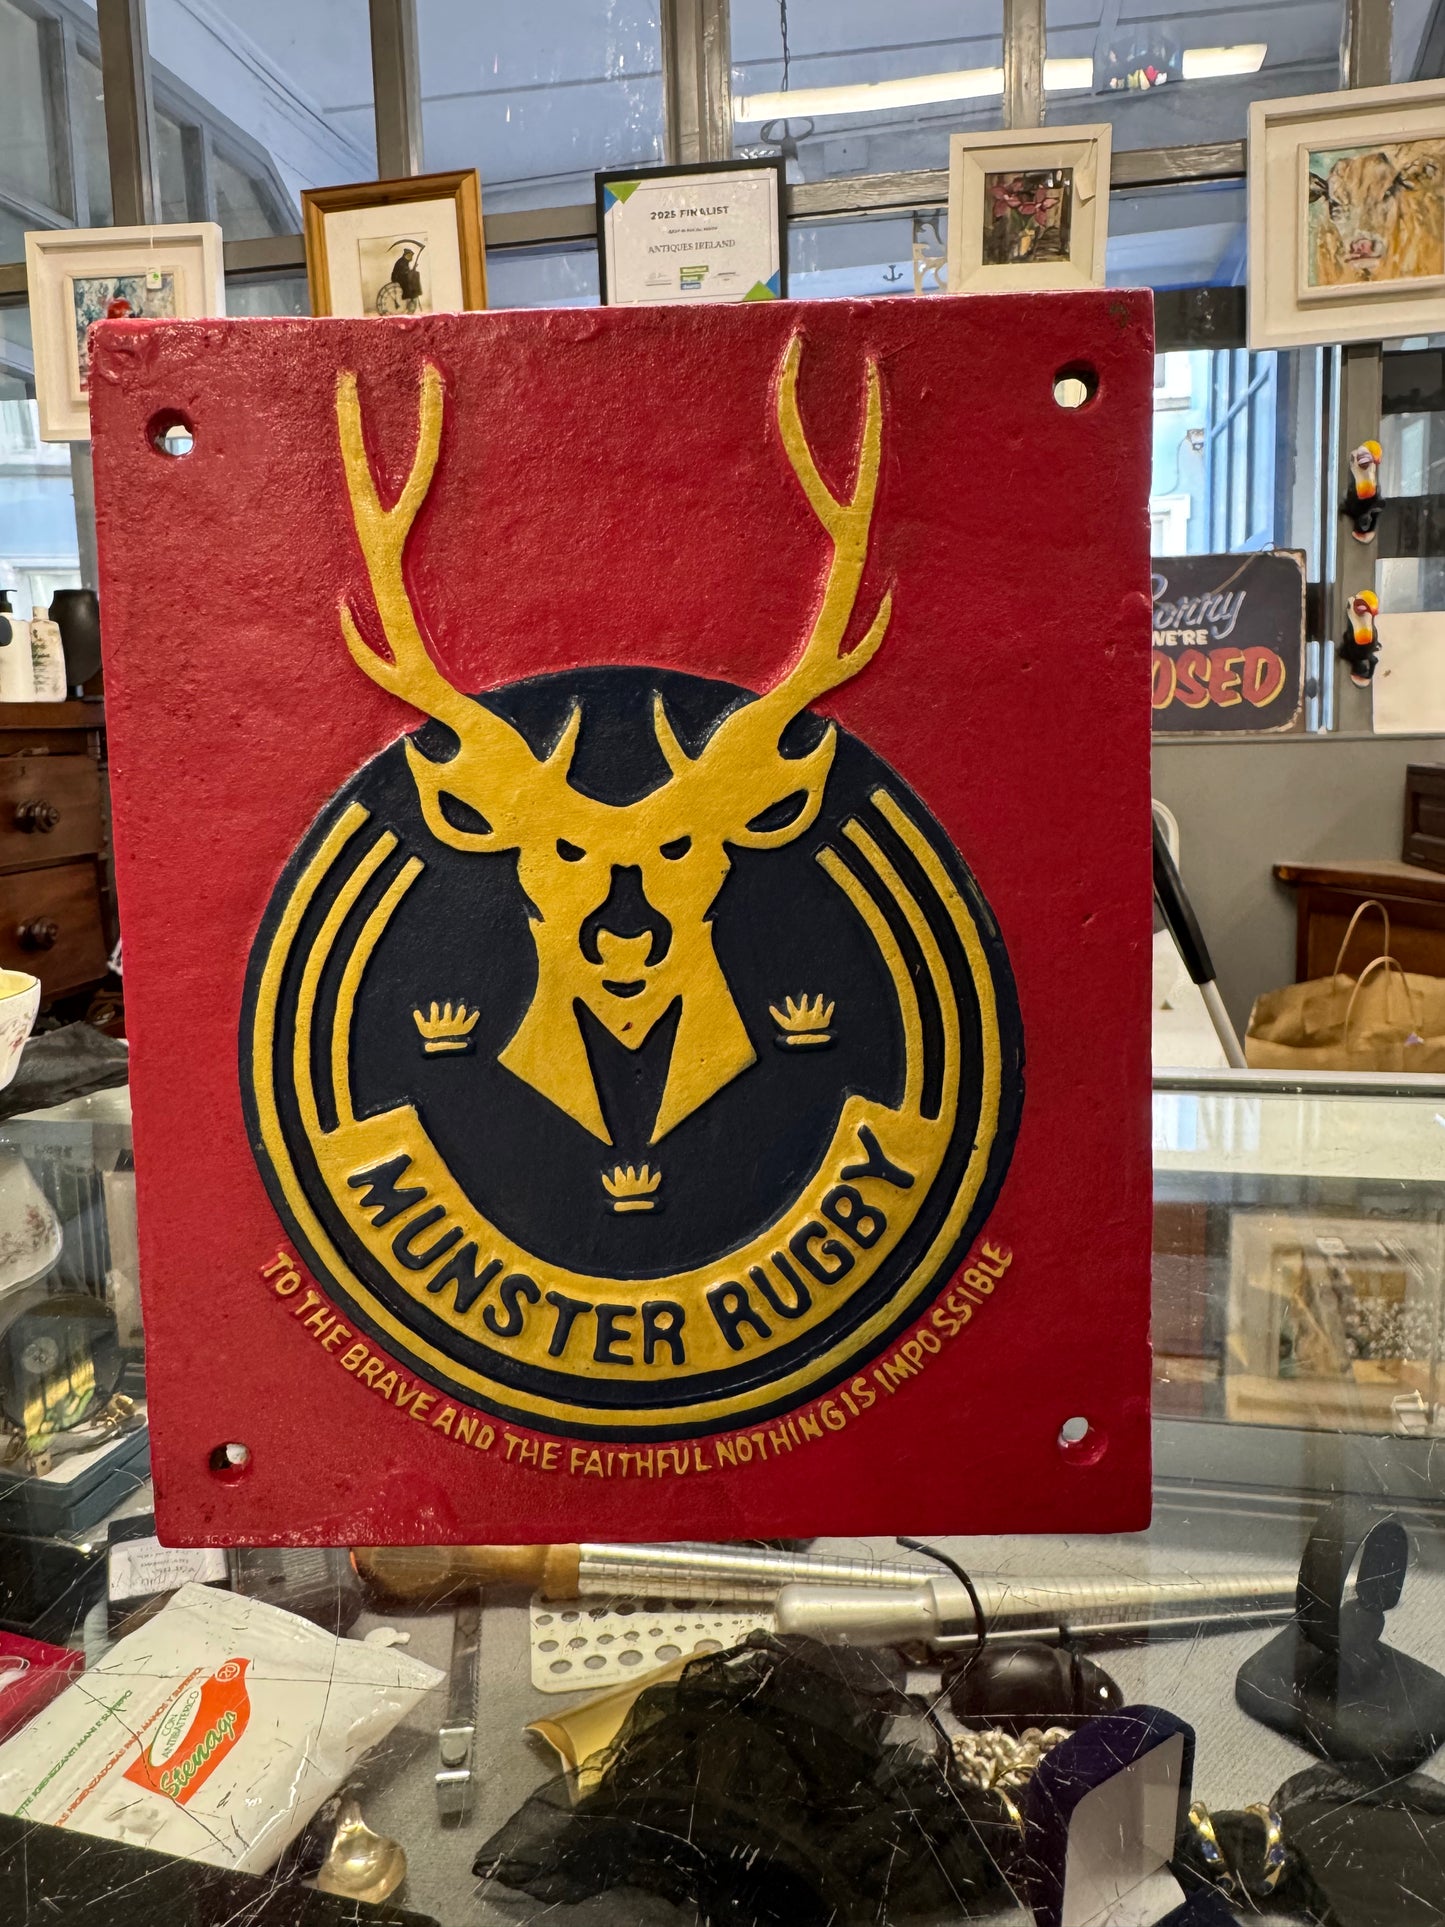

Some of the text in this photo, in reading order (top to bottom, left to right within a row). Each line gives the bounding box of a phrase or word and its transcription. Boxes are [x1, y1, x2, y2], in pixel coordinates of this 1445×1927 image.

[650, 206, 729, 220] 2025 FINALIST
[648, 239, 736, 254] ANTIQUES IRELAND
[1152, 646, 1287, 709] OSED
[347, 1123, 916, 1366] MUNSTER RUGBY
[263, 1242, 1014, 1478] TO THE BRAVE AND THE FAITHFUL NOTHING IS IMPOSSIBLE
[217, 1665, 238, 1679] 20
[161, 1714, 178, 1737] CON
[159, 1710, 238, 1797] Stenago
